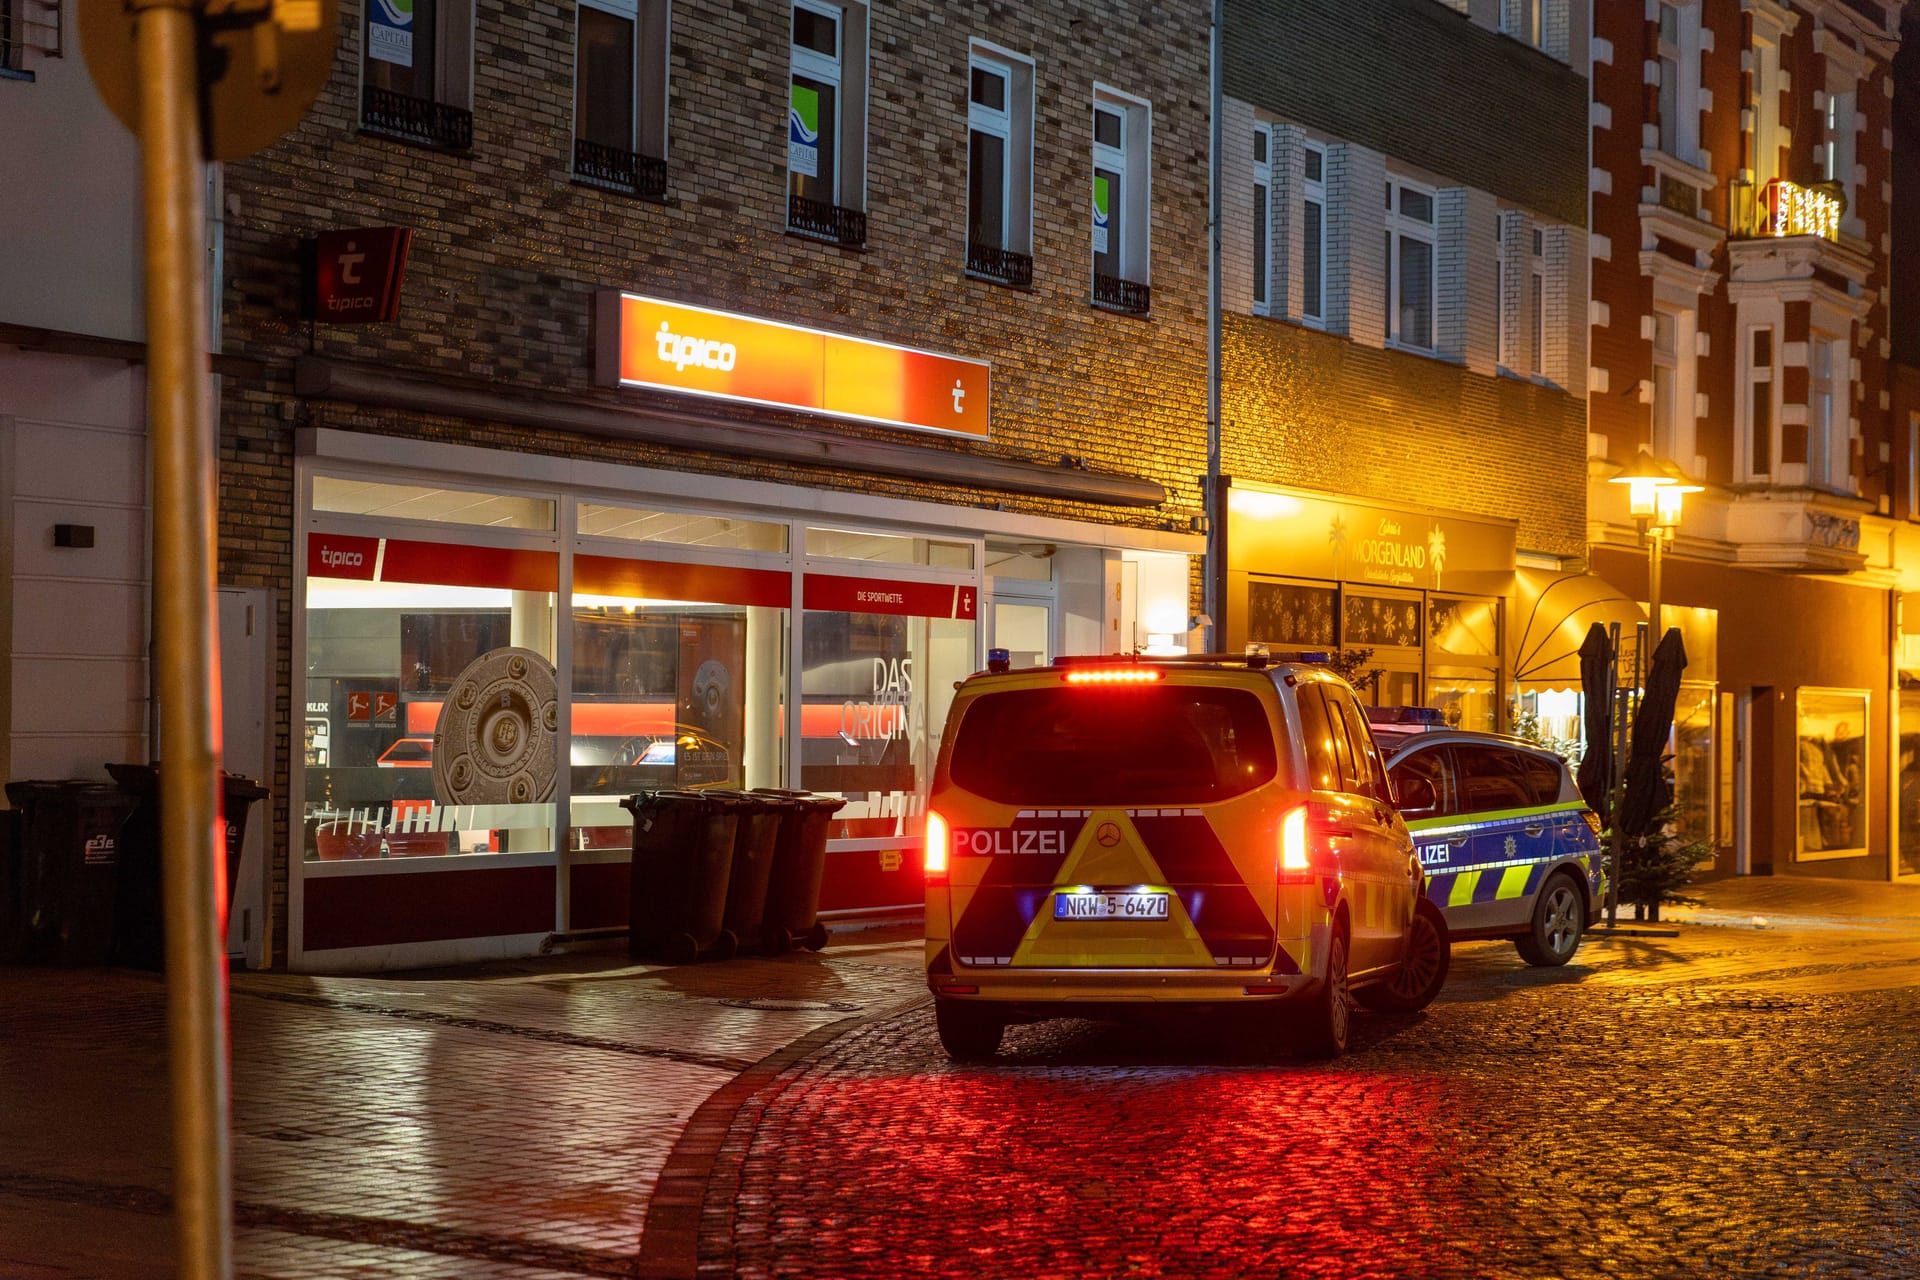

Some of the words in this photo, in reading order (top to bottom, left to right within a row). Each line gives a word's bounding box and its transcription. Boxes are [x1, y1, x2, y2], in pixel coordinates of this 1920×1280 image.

[328, 294, 374, 312] tipico
[656, 321, 737, 372] tipico
[321, 545, 363, 568] tipico
[1352, 539, 1425, 568] MORGENLAND
[857, 591, 867, 601] DIE
[873, 657, 912, 695] DAS
[306, 702, 329, 713] KLIX
[952, 830, 1065, 854] POLIZEI
[1417, 843, 1449, 865] LIZEI
[1066, 897, 1098, 916] NRW
[1107, 897, 1167, 916] 5-6470
